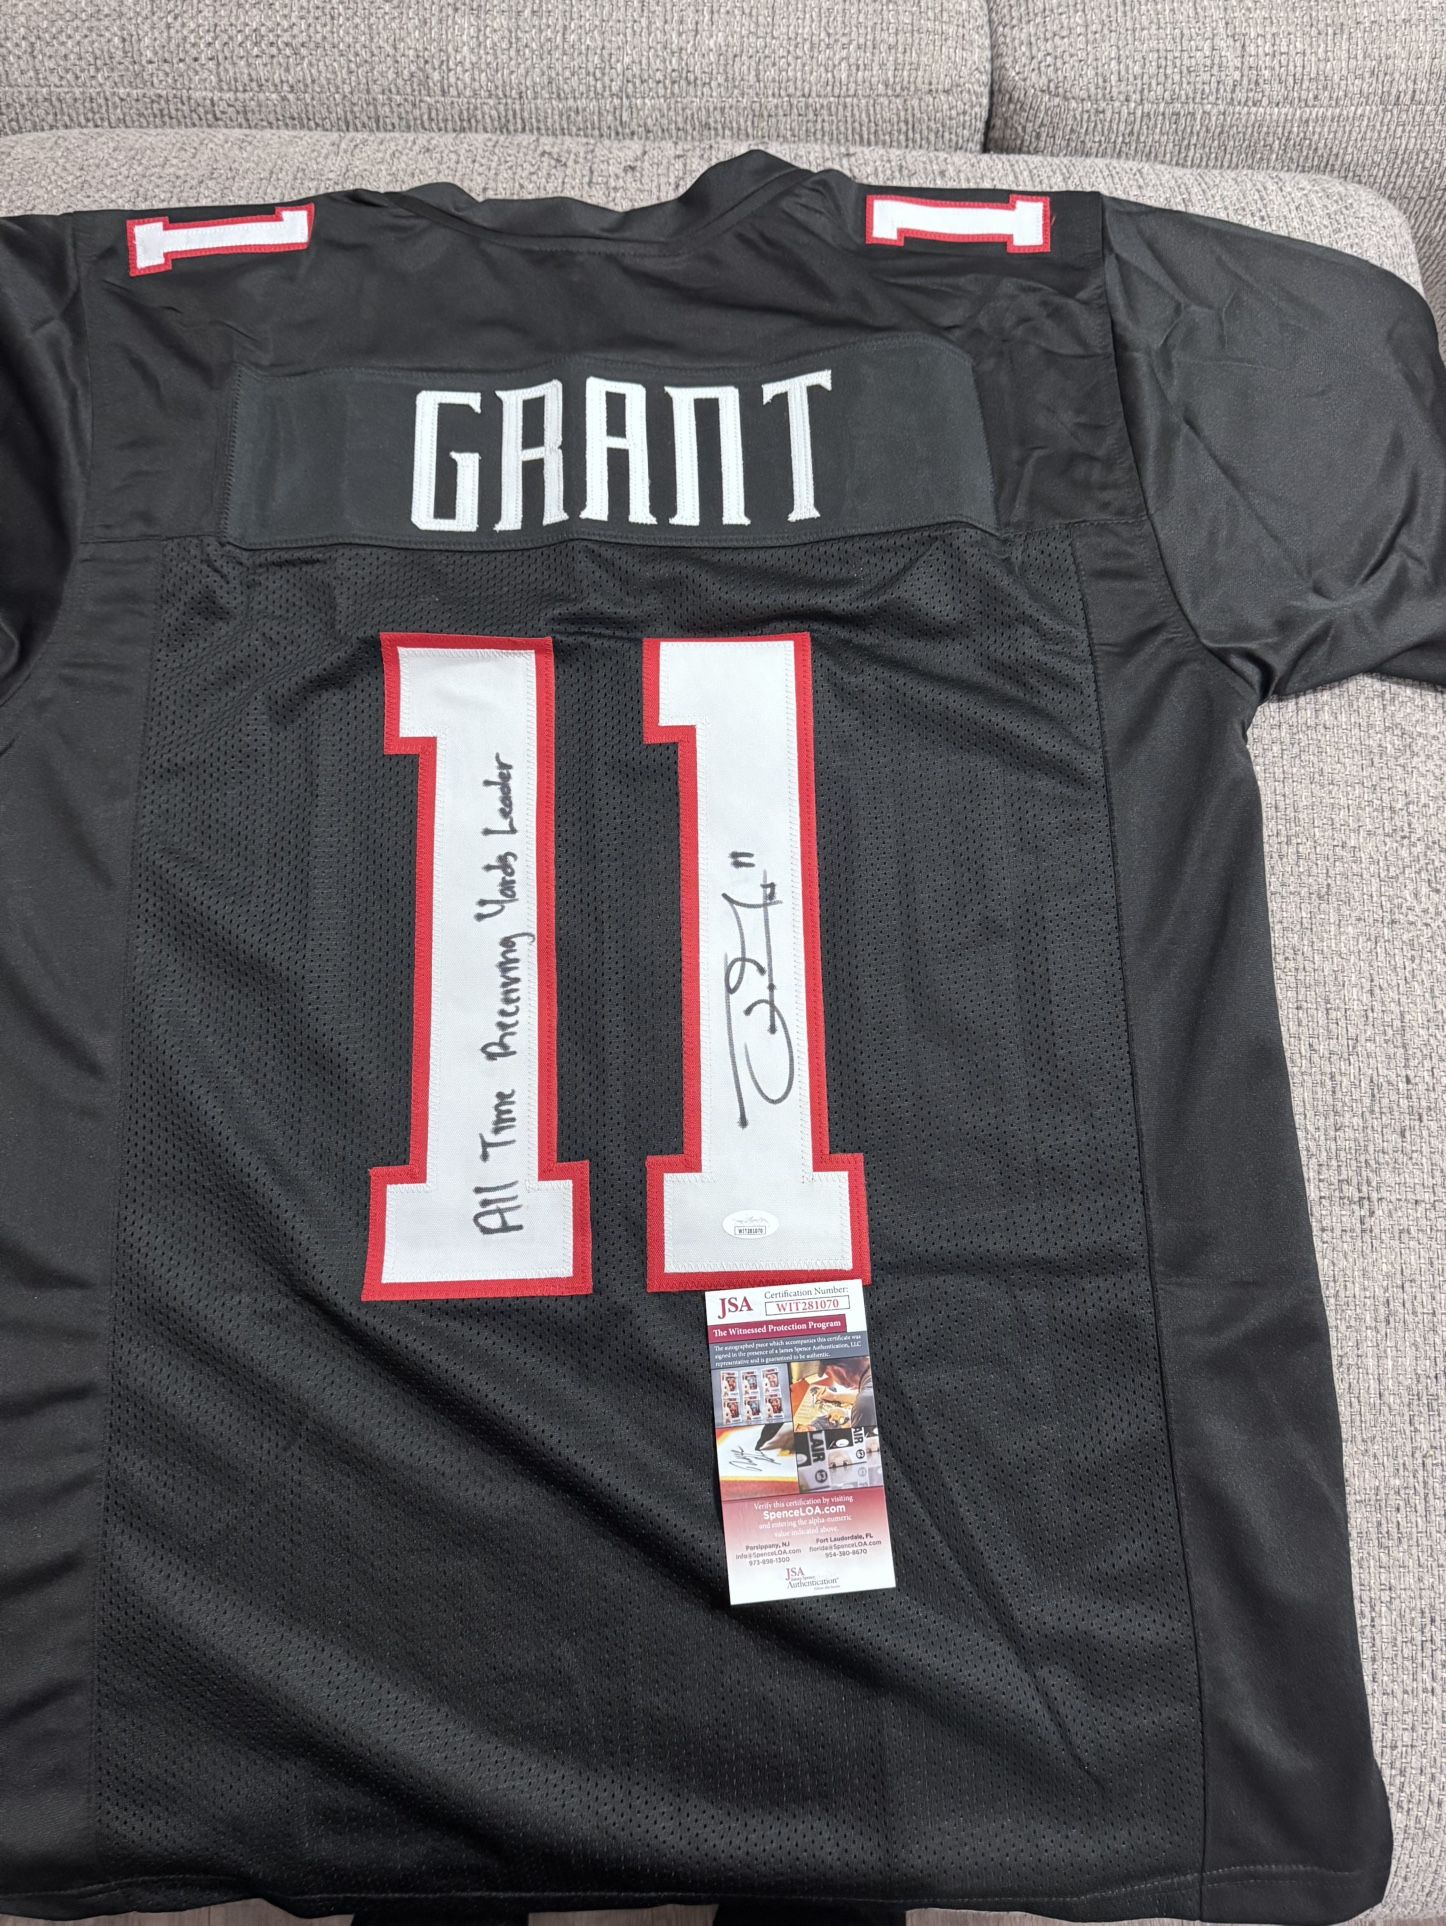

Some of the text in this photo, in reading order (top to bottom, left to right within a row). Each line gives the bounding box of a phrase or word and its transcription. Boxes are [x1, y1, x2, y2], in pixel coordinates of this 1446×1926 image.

[410, 369, 833, 533] GRANT
[483, 754, 517, 835] Leader
[475, 852, 517, 921] Yards
[362, 631, 871, 1302] 11
[480, 1090, 516, 1162] Time
[473, 1182, 523, 1234] All
[764, 1286, 848, 1299] Certification Number:
[717, 1296, 754, 1319] JSA
[776, 1298, 839, 1312] WIT281070
[712, 1319, 841, 1337] The Witnessed Protection Program
[754, 1493, 854, 1512] Verify this certification by visiting
[763, 1503, 845, 1520] SpenceLOA.com
[758, 1522, 770, 1530] and
[771, 1519, 797, 1529] entering
[797, 1518, 808, 1526] the
[773, 1530, 790, 1538] value
[830, 1533, 865, 1543] Lauderdale,
[745, 1543, 781, 1551] Parsippany,
[785, 1566, 805, 1581] JSA
